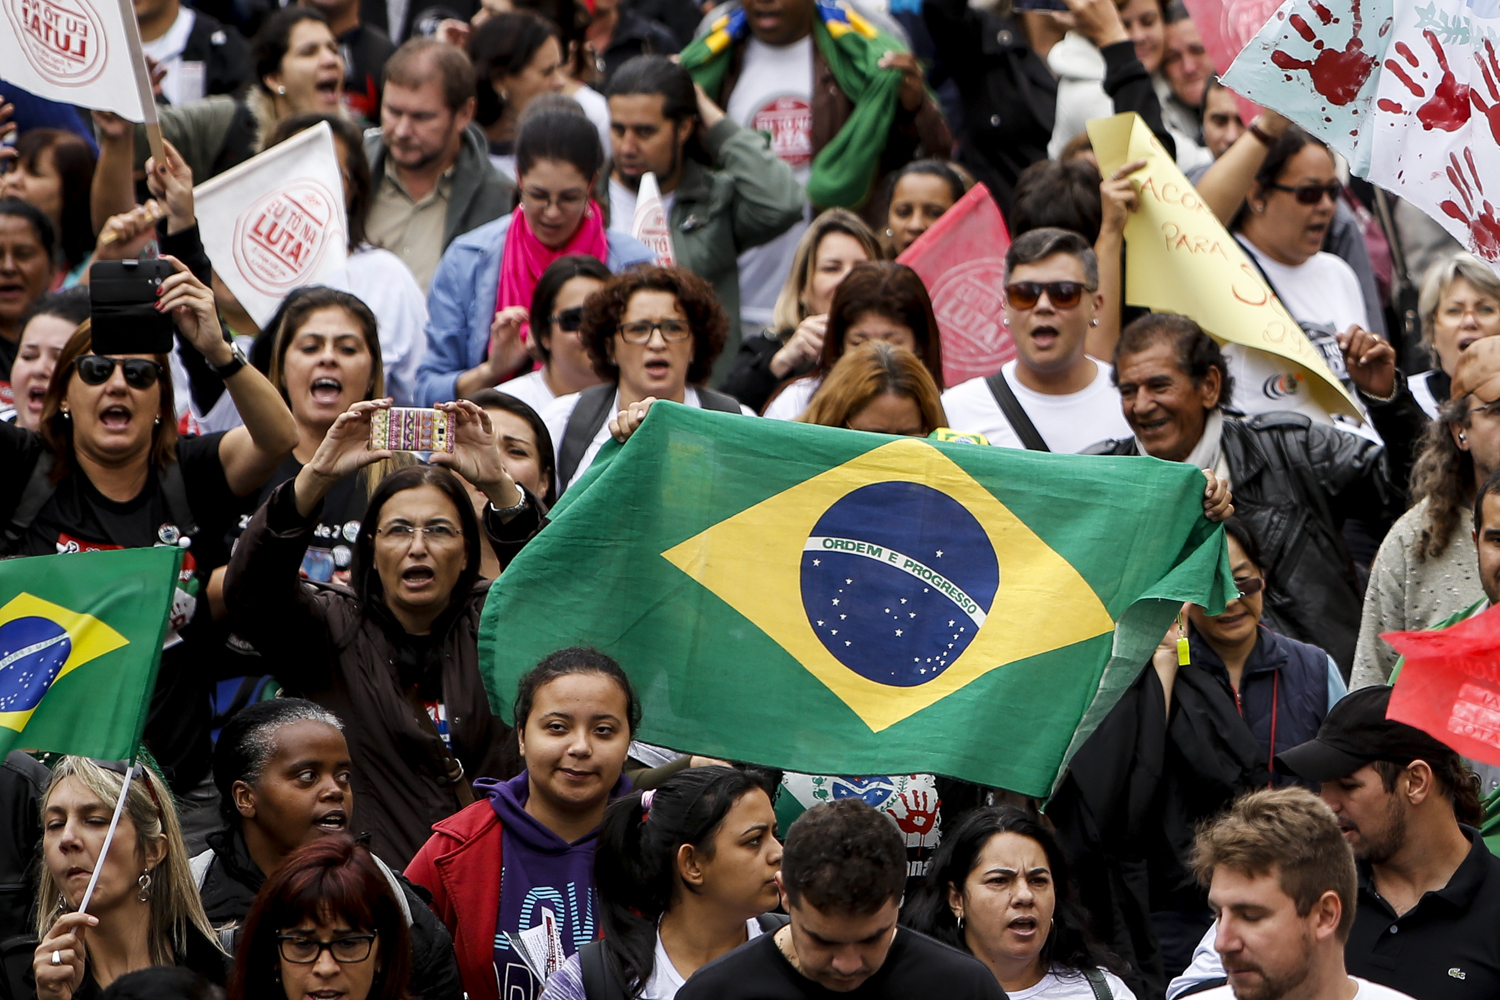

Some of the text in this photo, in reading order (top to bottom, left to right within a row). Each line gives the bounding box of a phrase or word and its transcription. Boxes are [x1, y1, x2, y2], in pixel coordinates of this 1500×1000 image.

[252, 213, 311, 267] LUTA!
[300, 222, 317, 245] NA
[1161, 221, 1228, 260] PARA
[939, 298, 1009, 350] LUTA!
[822, 537, 978, 615] ORDEM E PROGRESSO
